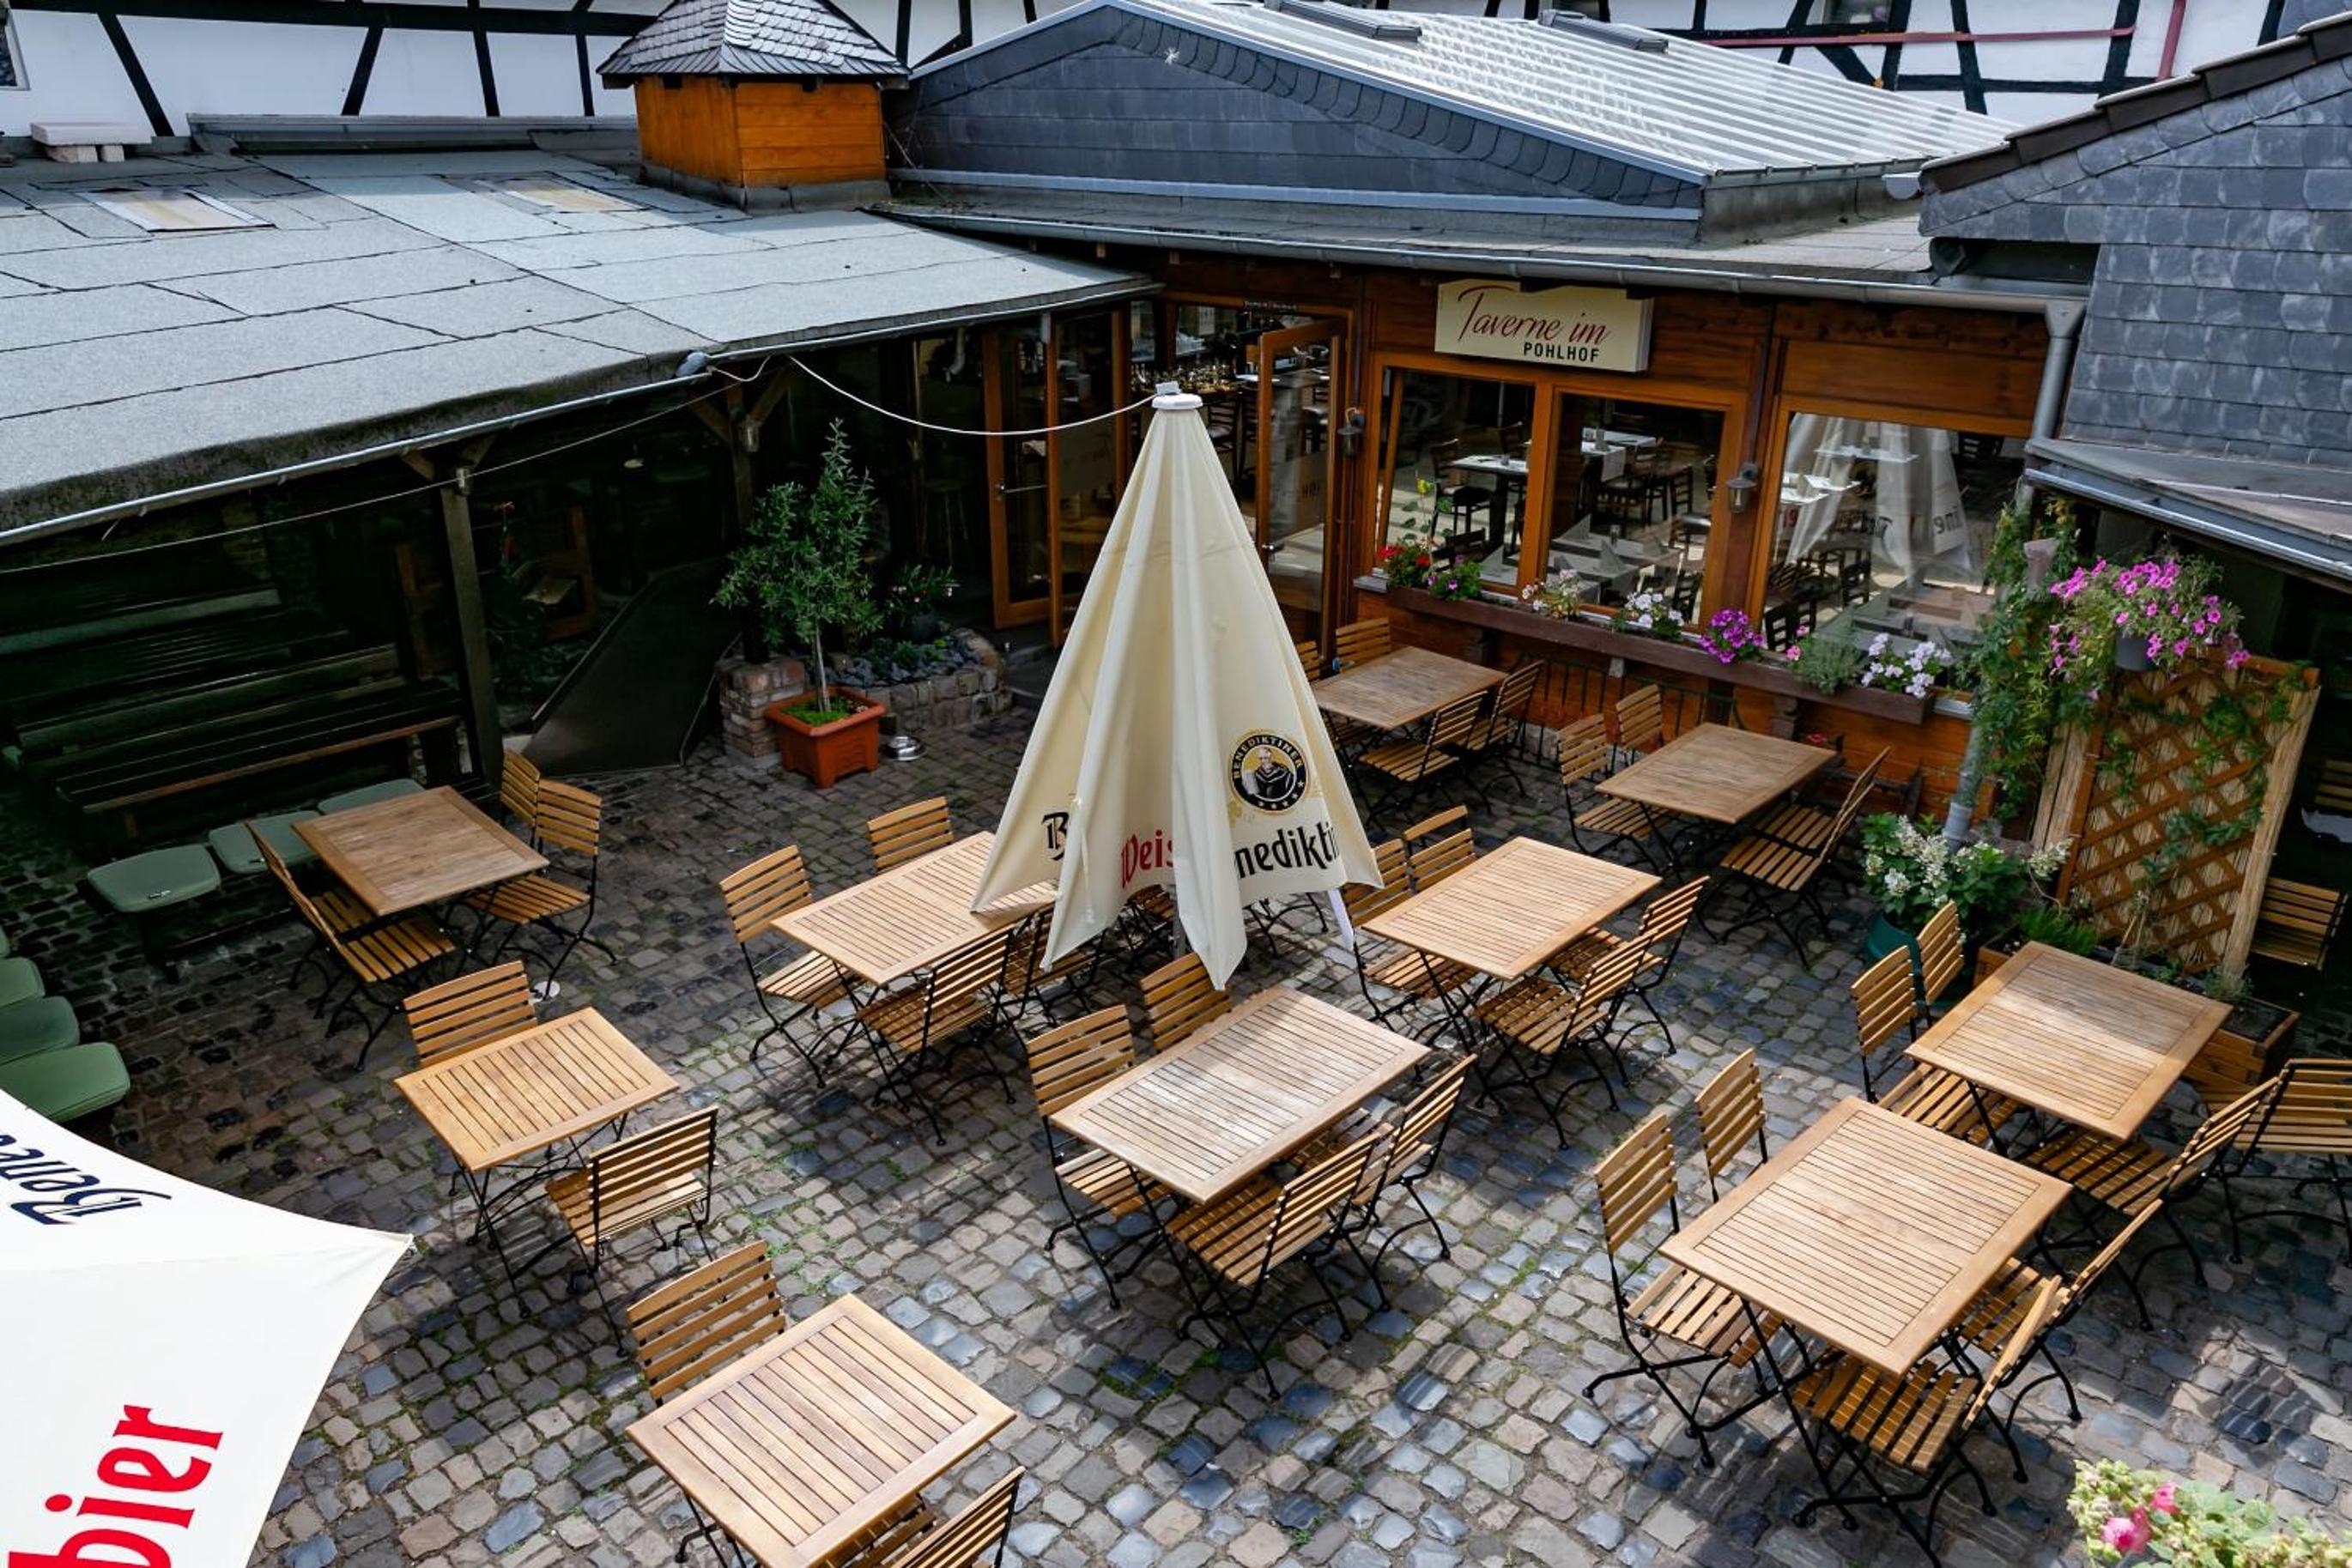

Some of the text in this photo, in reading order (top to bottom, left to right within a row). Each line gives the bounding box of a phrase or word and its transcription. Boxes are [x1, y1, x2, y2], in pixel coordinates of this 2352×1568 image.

[1458, 285, 1610, 345] Taverne im
[1524, 342, 1600, 362] POHLHOF
[1233, 736, 1304, 779] BENEDIKTINER
[8, 1404, 224, 1568] bier
